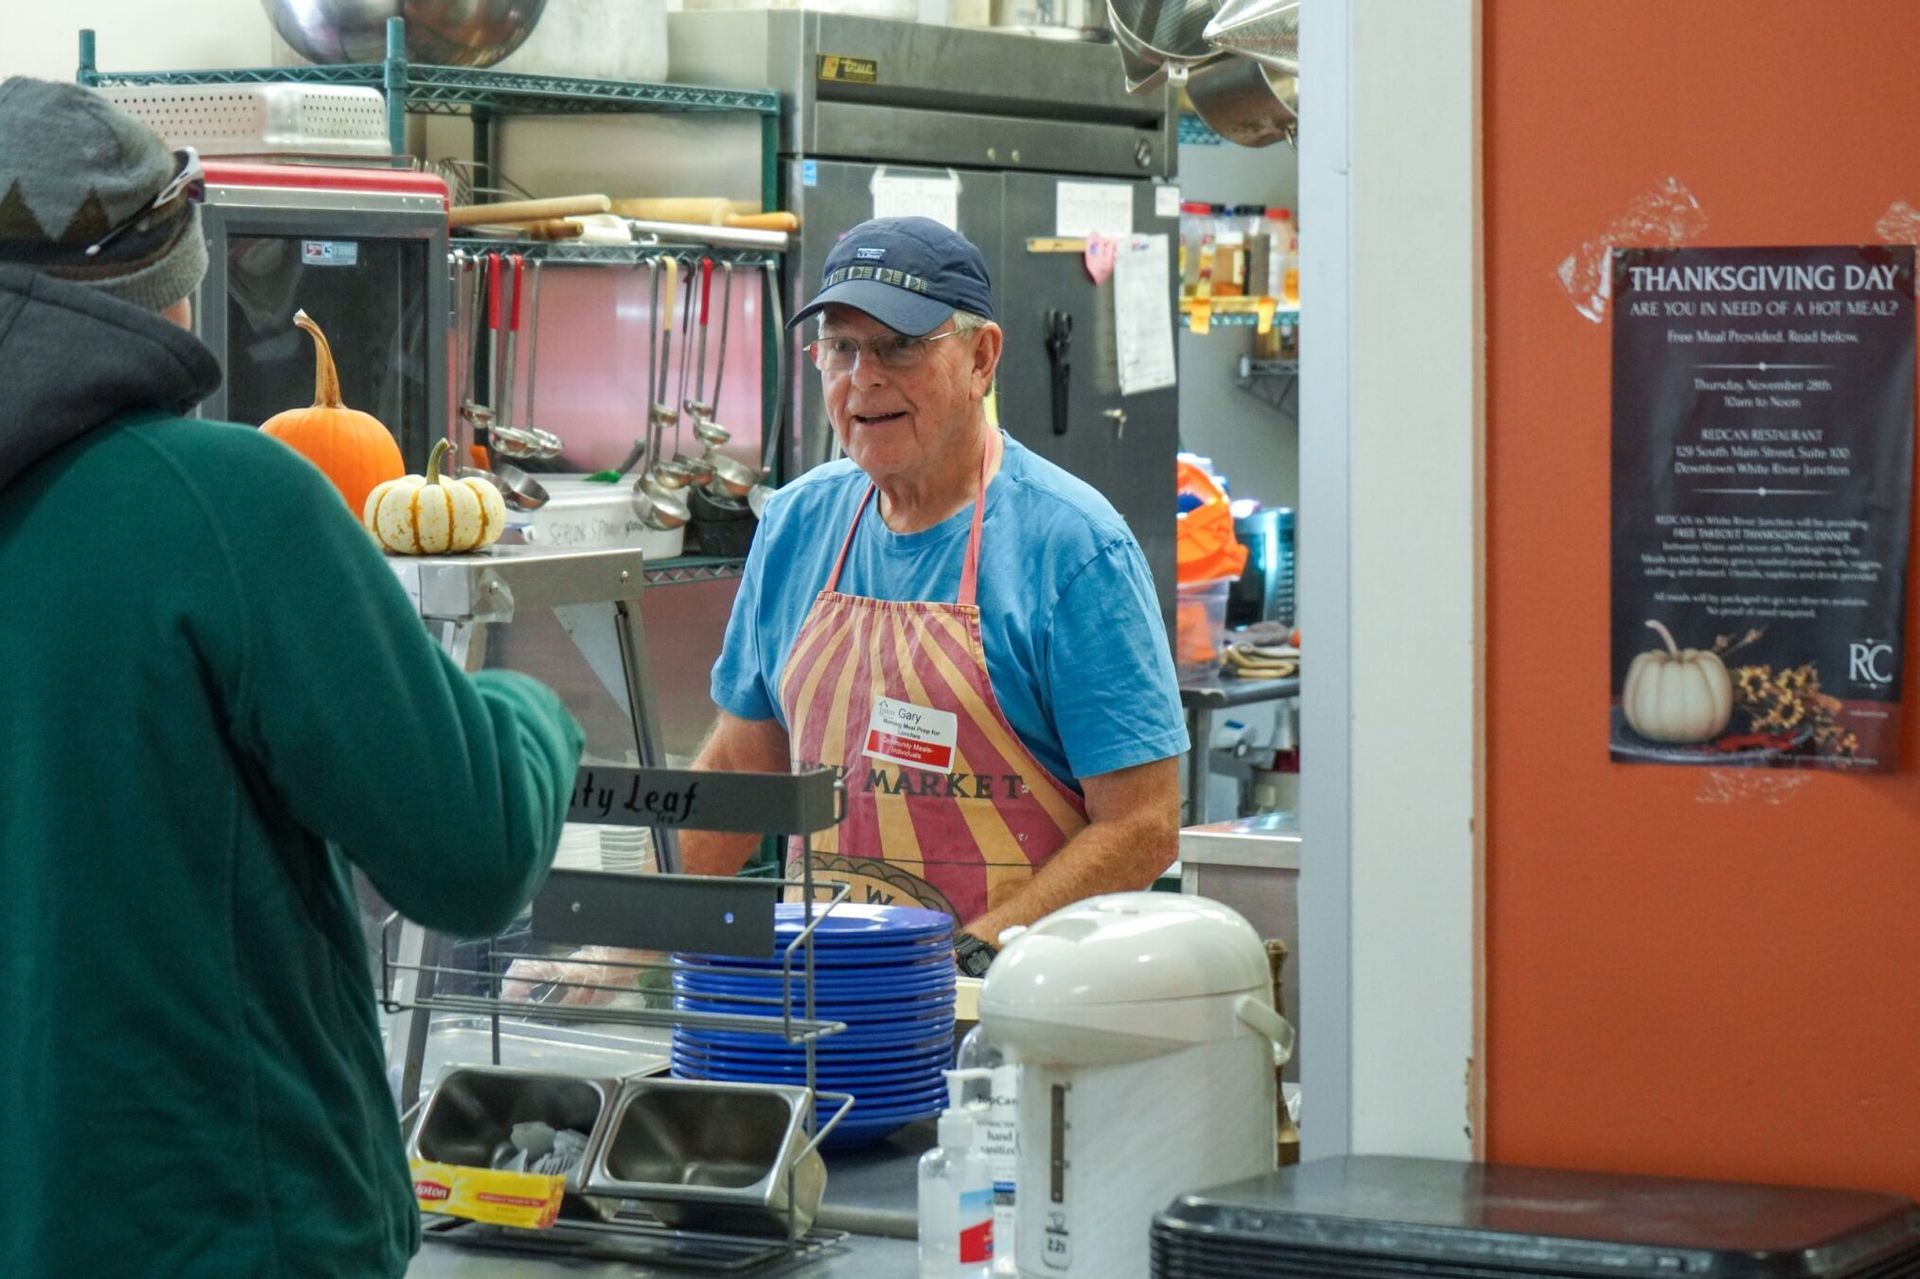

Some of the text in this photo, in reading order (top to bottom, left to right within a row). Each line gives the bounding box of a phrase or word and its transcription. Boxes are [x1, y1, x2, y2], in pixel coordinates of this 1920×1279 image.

[1629, 265, 1899, 292] THANKSGIVING DAY
[1630, 300, 1899, 317] ARE YOU IN NEED OF A HOT MEAL?
[1667, 330, 1694, 343] Free
[1696, 330, 1726, 343] Meal
[1728, 329, 1784, 344] Provided.
[1788, 330, 1818, 343] Read
[1746, 378, 1804, 391] November
[1755, 396, 1768, 408] to
[1769, 395, 1801, 409] Noon
[1751, 428, 1823, 442] RESTAURANT
[1695, 445, 1729, 459] South
[1731, 445, 1760, 459] Main
[1797, 446, 1827, 459] Suite
[1674, 462, 1851, 478] Downtown White River Junction
[898, 708, 922, 724] Gary
[903, 723, 916, 731] Meal
[917, 727, 931, 735] Prep
[864, 768, 1023, 799] MARKET
[623, 775, 699, 822] Leaf
[415, 1183, 448, 1199] ipton
